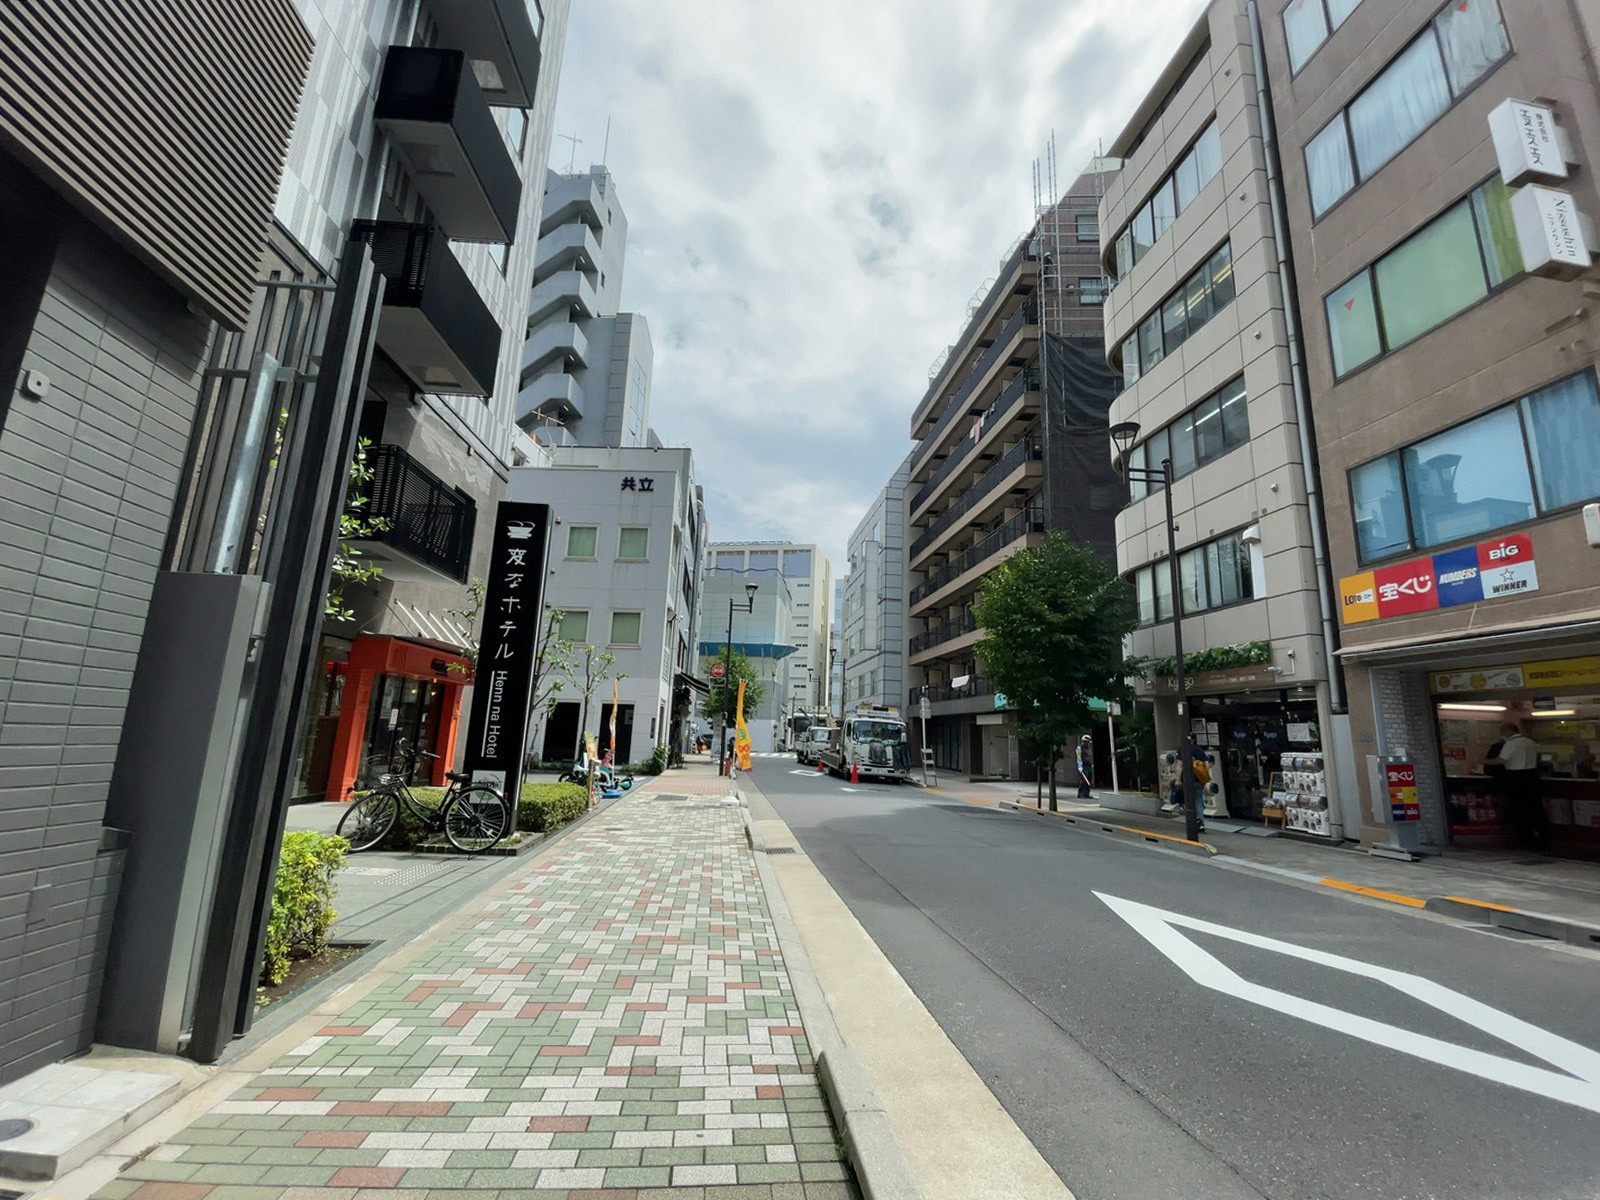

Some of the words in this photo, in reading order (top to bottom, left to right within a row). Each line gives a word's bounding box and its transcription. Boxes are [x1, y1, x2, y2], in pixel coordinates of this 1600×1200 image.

[620, 476, 654, 492] 共立
[1439, 567, 1478, 585] NUMBERS
[1378, 574, 1432, 602] 宝くじ
[1491, 579, 1528, 594] WINNER
[494, 547, 528, 660] 変なホテル
[492, 670, 509, 703] Henn
[490, 705, 502, 722] na
[485, 724, 502, 759] Hotel
[1387, 771, 1414, 782] 宝くじ
